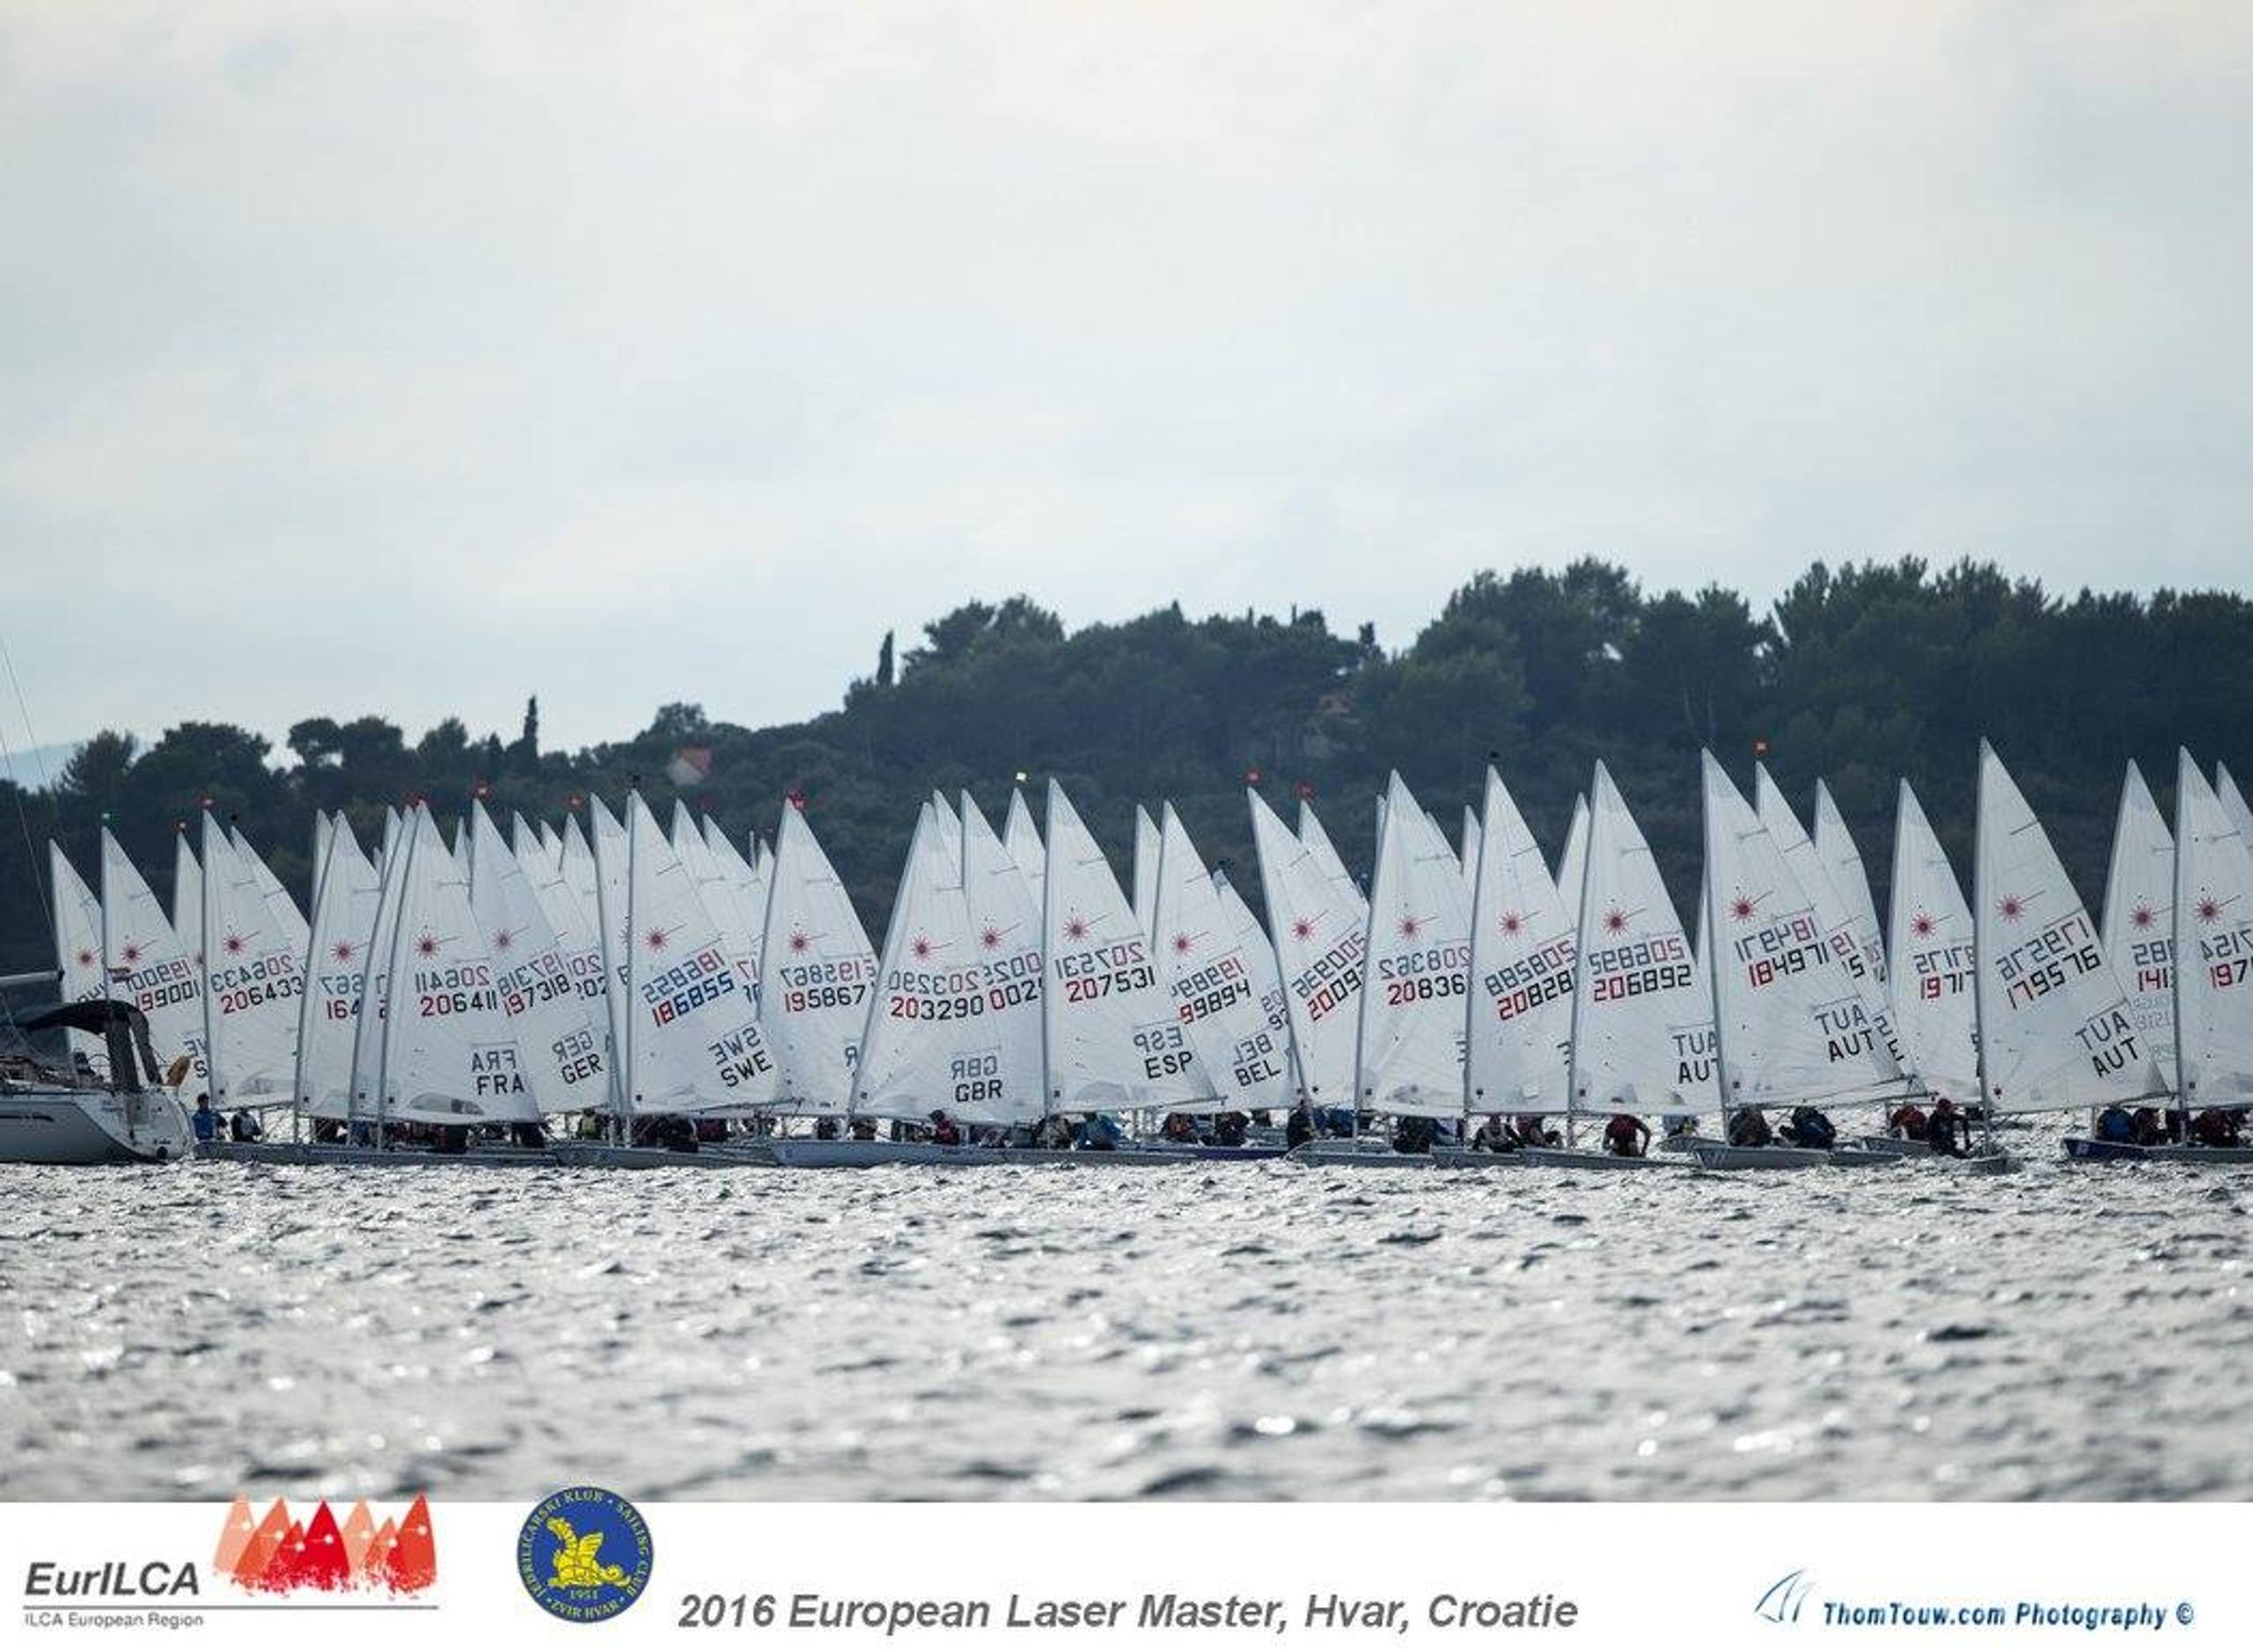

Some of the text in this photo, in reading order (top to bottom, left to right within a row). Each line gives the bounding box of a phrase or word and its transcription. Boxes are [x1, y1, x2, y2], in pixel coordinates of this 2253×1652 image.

[1749, 942, 1829, 988] 184971
[2006, 943, 2102, 1010] 179576
[2210, 956, 2253, 989] 197
[222, 976, 304, 1016] 206433
[503, 974, 571, 1017] 197318
[651, 970, 735, 1027] 186855
[785, 985, 866, 1013] 195867
[1066, 966, 1156, 1002] 207531
[1593, 965, 1692, 1002] 206892
[421, 990, 497, 1017] 206411
[891, 995, 984, 1020] 203290
[1828, 1028, 1875, 1063] AUT
[2091, 1036, 2139, 1078] AUT
[561, 1054, 605, 1084] GER
[720, 1049, 773, 1088] SWE
[1145, 1051, 1193, 1079] ESP
[1235, 1060, 1282, 1087] BEL
[476, 1073, 525, 1096] FRA
[954, 1079, 1003, 1102] GBR
